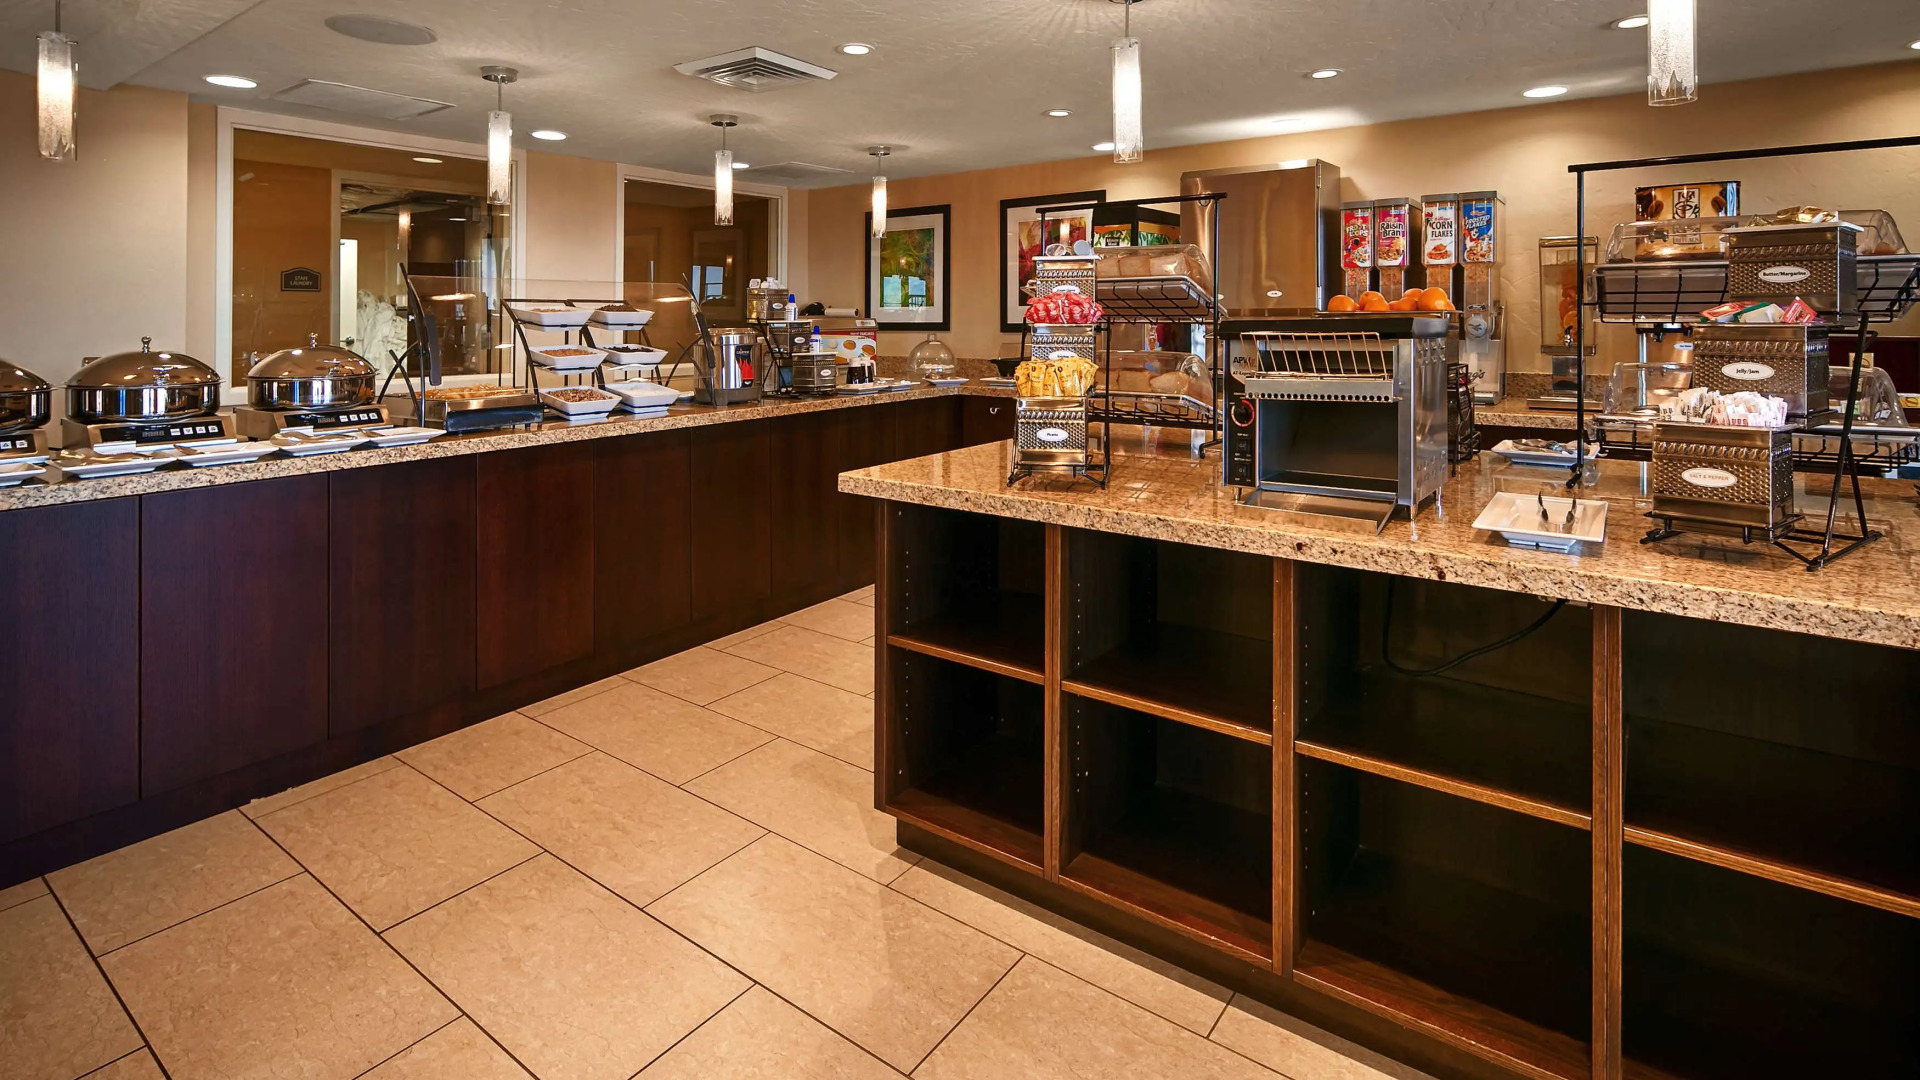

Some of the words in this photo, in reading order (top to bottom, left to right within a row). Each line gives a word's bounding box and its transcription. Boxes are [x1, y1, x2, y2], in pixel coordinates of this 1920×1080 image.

[1380, 222, 1404, 231] Raisin
[1431, 221, 1453, 230] CORN
[1382, 229, 1401, 238] Bran
[1431, 230, 1453, 238] FLAKES
